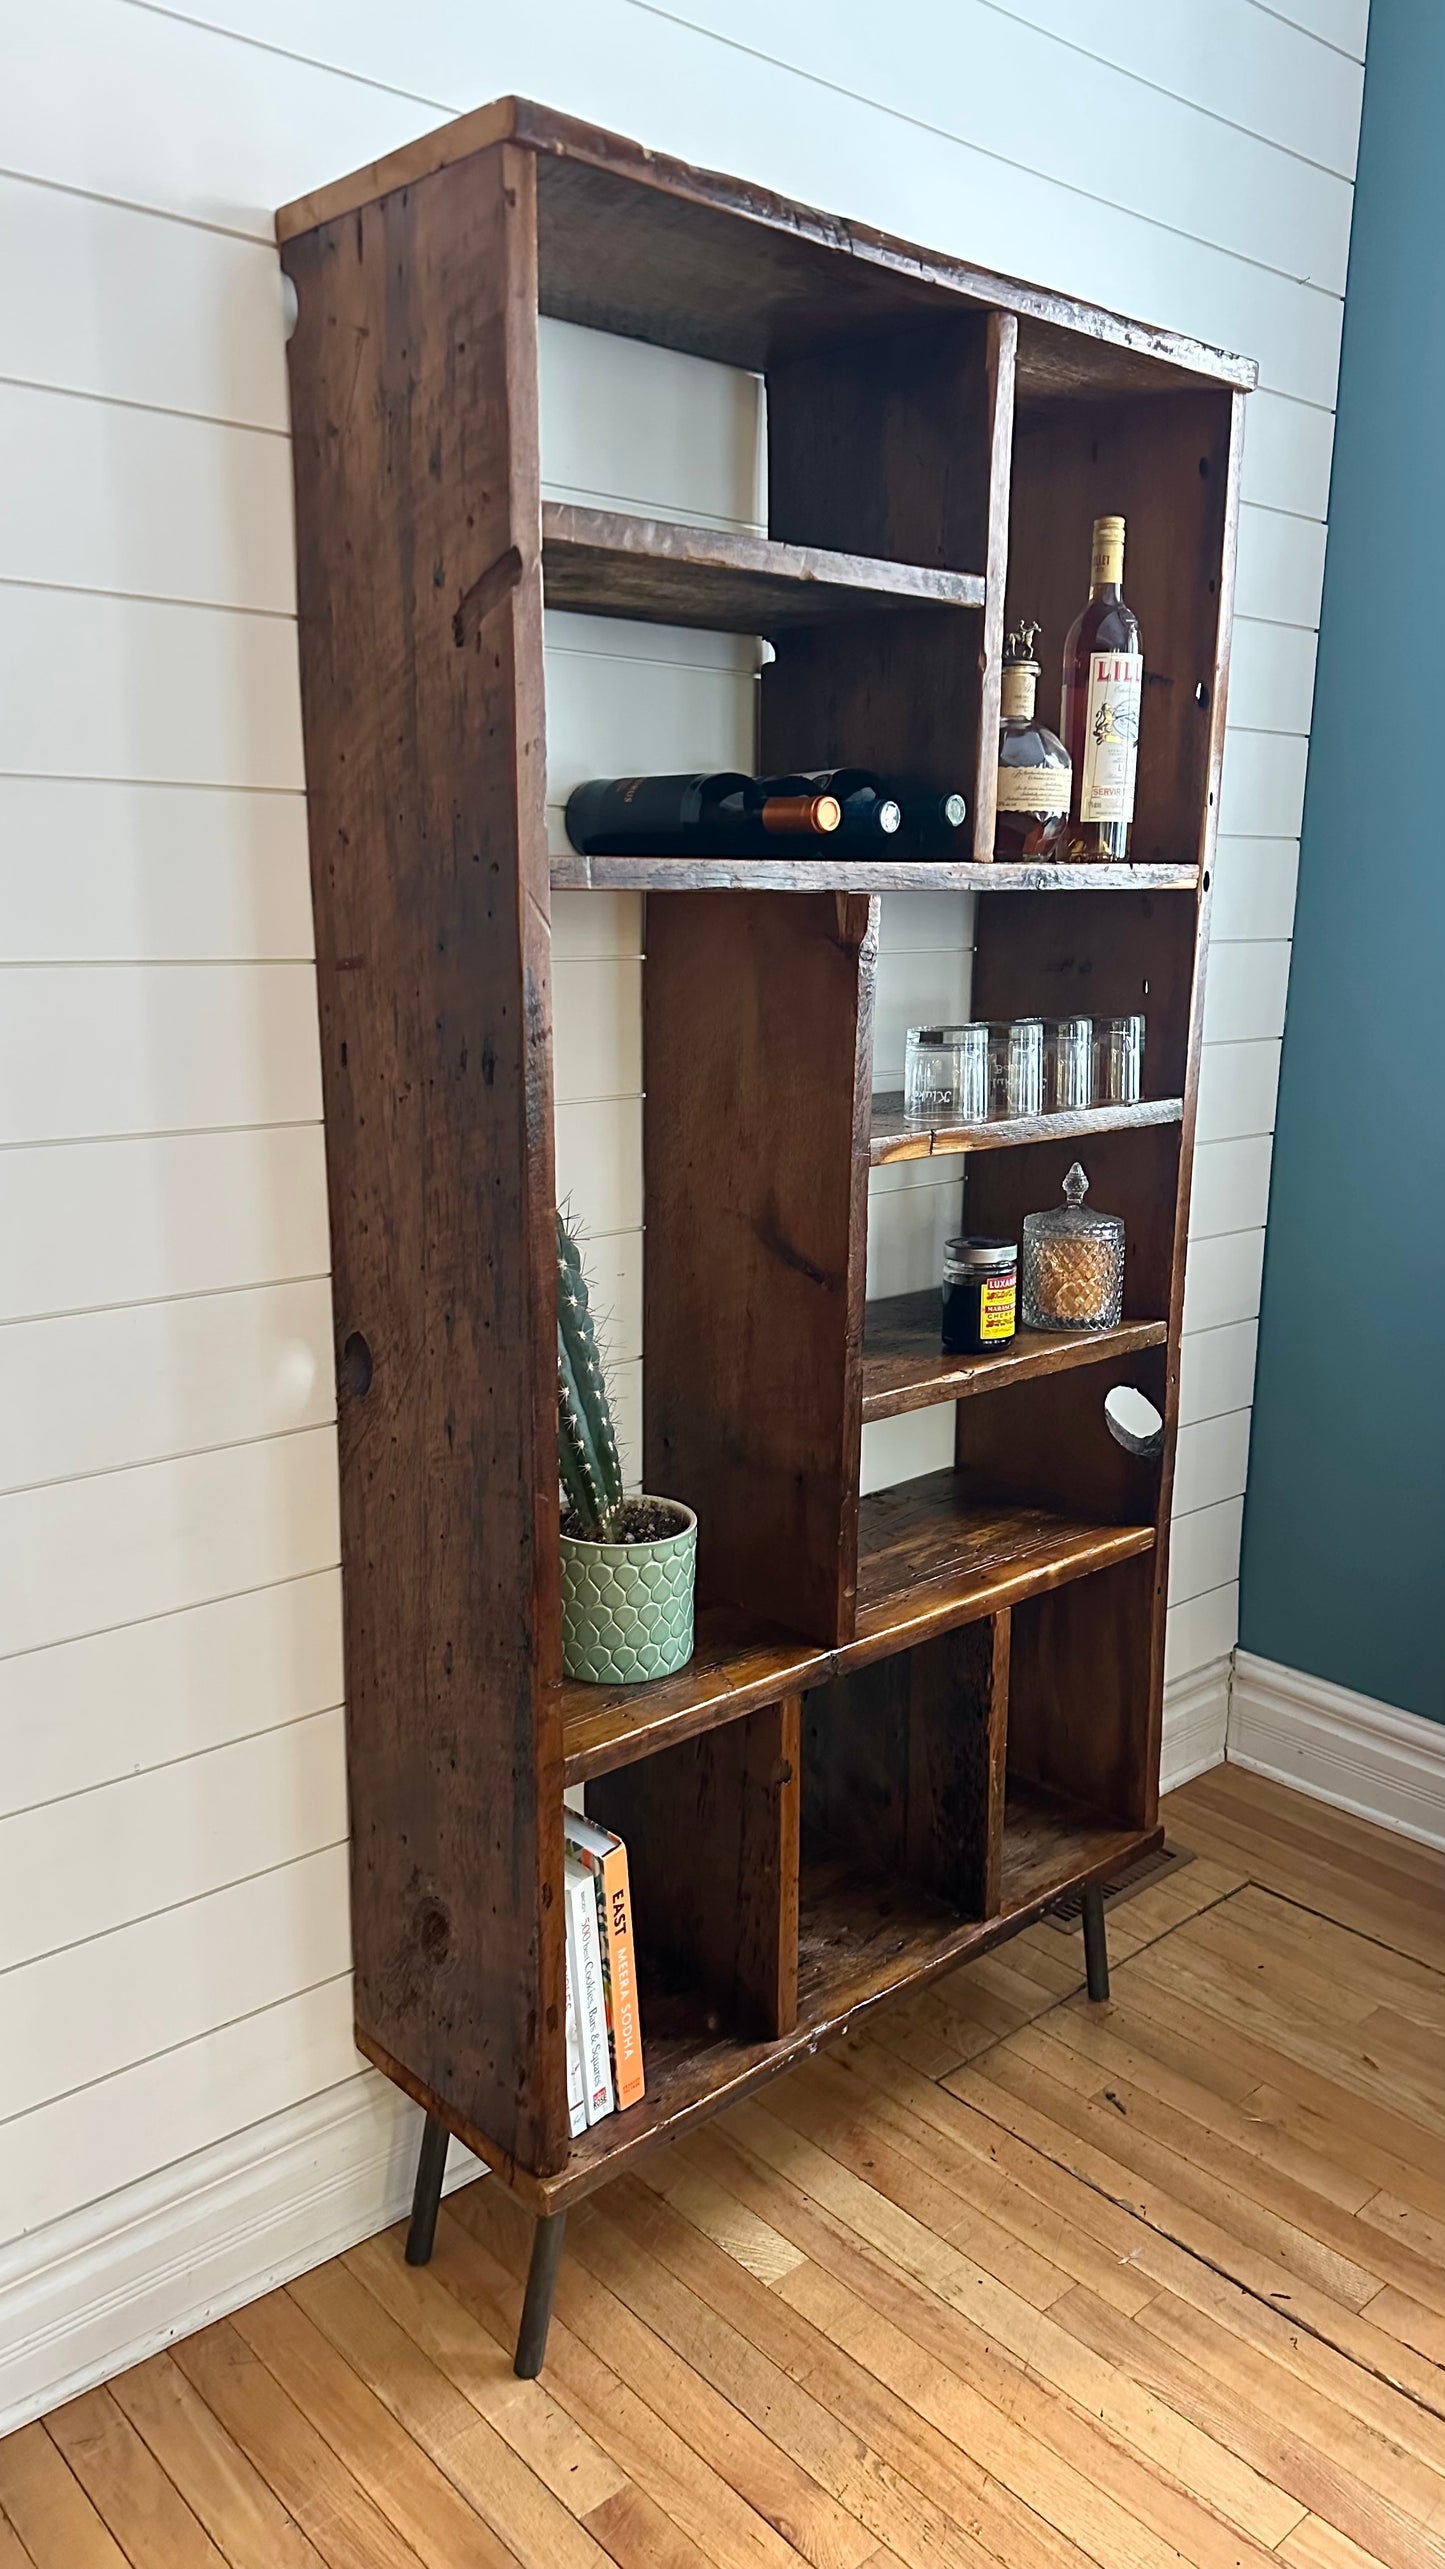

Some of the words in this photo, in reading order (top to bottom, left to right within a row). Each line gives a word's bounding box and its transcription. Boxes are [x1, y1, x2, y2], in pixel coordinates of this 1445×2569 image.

[1093, 788, 1121, 796] SERVIR
[581, 1917, 591, 1942] 500
[613, 1889, 627, 1937] EAST
[583, 1941, 592, 1961] best
[584, 1961, 597, 2009] Cookies,
[617, 1947, 631, 2001] MEERA
[588, 2007, 598, 2032] Bars
[621, 2004, 634, 2060] SODHA
[590, 2044, 602, 2088] Squares
